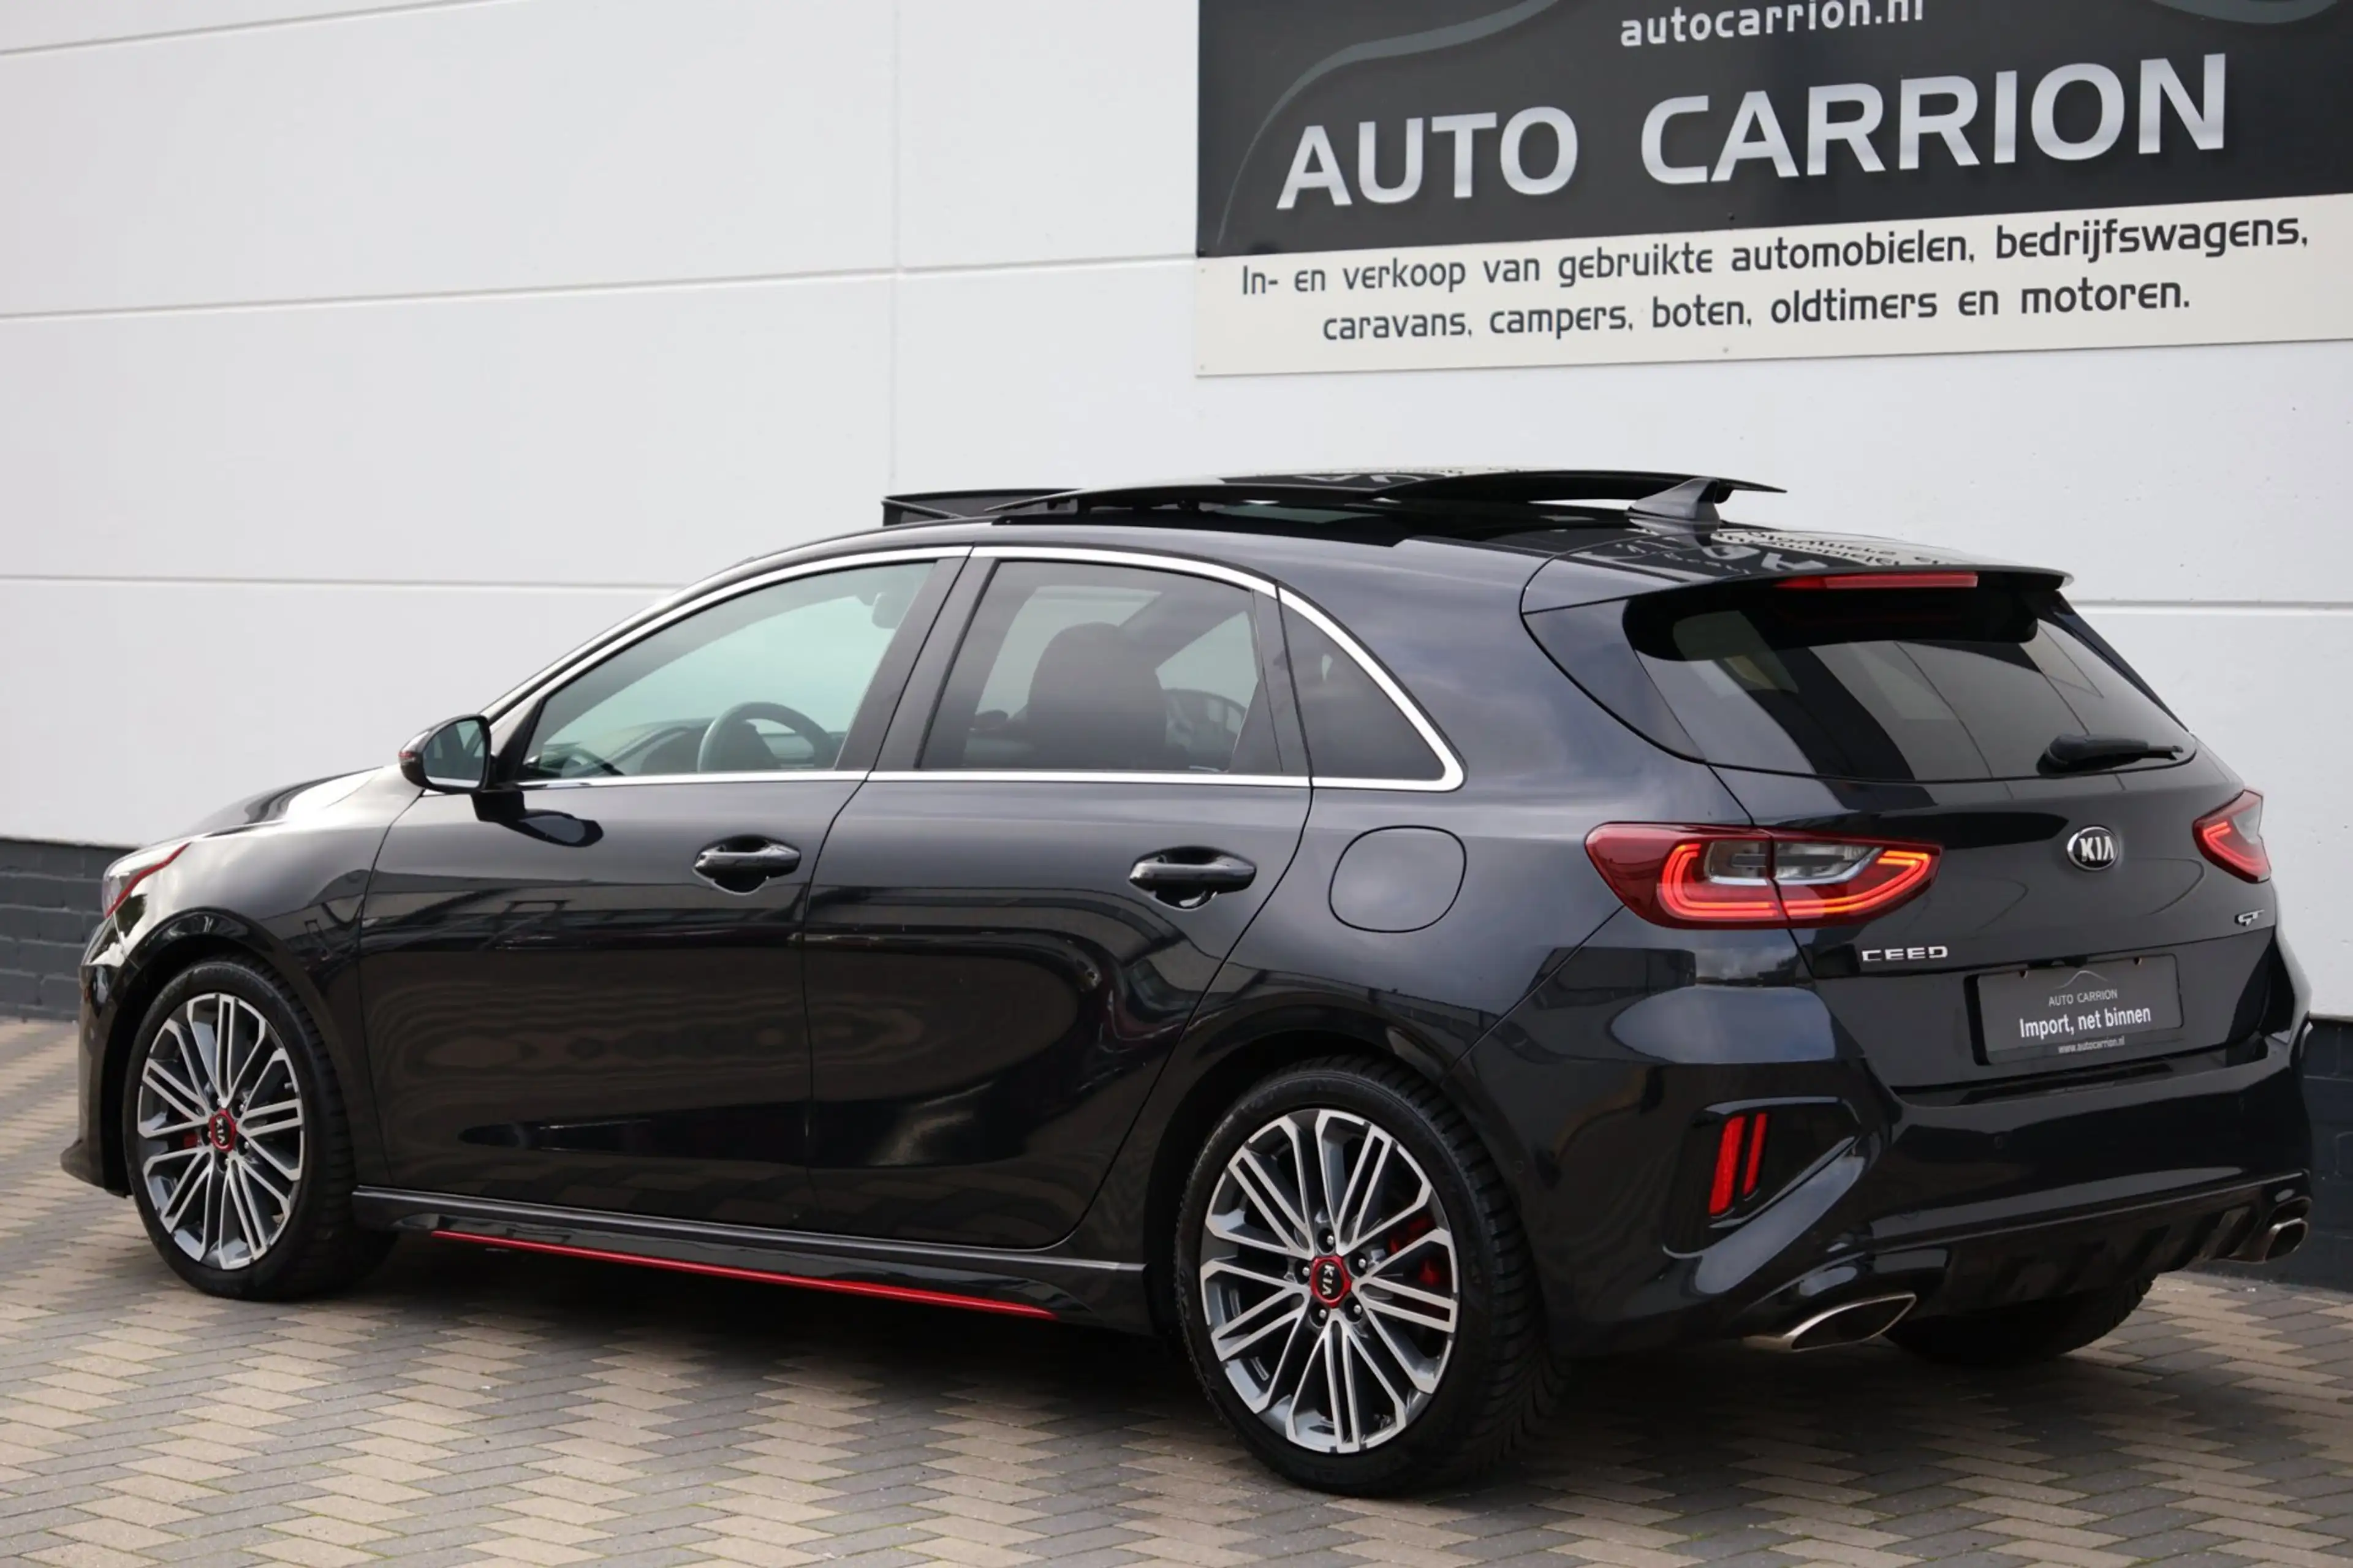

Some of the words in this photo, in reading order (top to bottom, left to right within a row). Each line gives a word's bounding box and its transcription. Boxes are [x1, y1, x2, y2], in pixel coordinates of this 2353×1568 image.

[1276, 107, 1578, 210] AUTO
[1641, 53, 2226, 184] CARRION
[1243, 265, 1278, 295] In-
[1294, 269, 1326, 292] en
[1343, 258, 1466, 293] verkoop
[1483, 258, 1540, 284] van
[1558, 243, 1713, 288] gebruikte
[1731, 230, 1974, 271] automobielen,
[1996, 218, 2308, 263] bedrijfswagens,
[1324, 312, 1472, 340] caravans,
[1490, 306, 1634, 339] campers,
[1653, 294, 1751, 328] boten,
[1771, 289, 1938, 324] oldtimers
[1958, 290, 1999, 316] en
[2021, 277, 2190, 314] motoren.
[2079, 835, 2114, 861] KIA
[1862, 945, 1948, 961] CEED
[2048, 994, 2074, 1007] AUTO
[2077, 989, 2118, 1004] CARRION
[2019, 1013, 2075, 1040] Import,
[2077, 1010, 2102, 1031] net
[2104, 1007, 2151, 1027] binnen
[2058, 1036, 2125, 1054] www.autocarrion.nl
[1322, 1264, 1335, 1295] KIA
